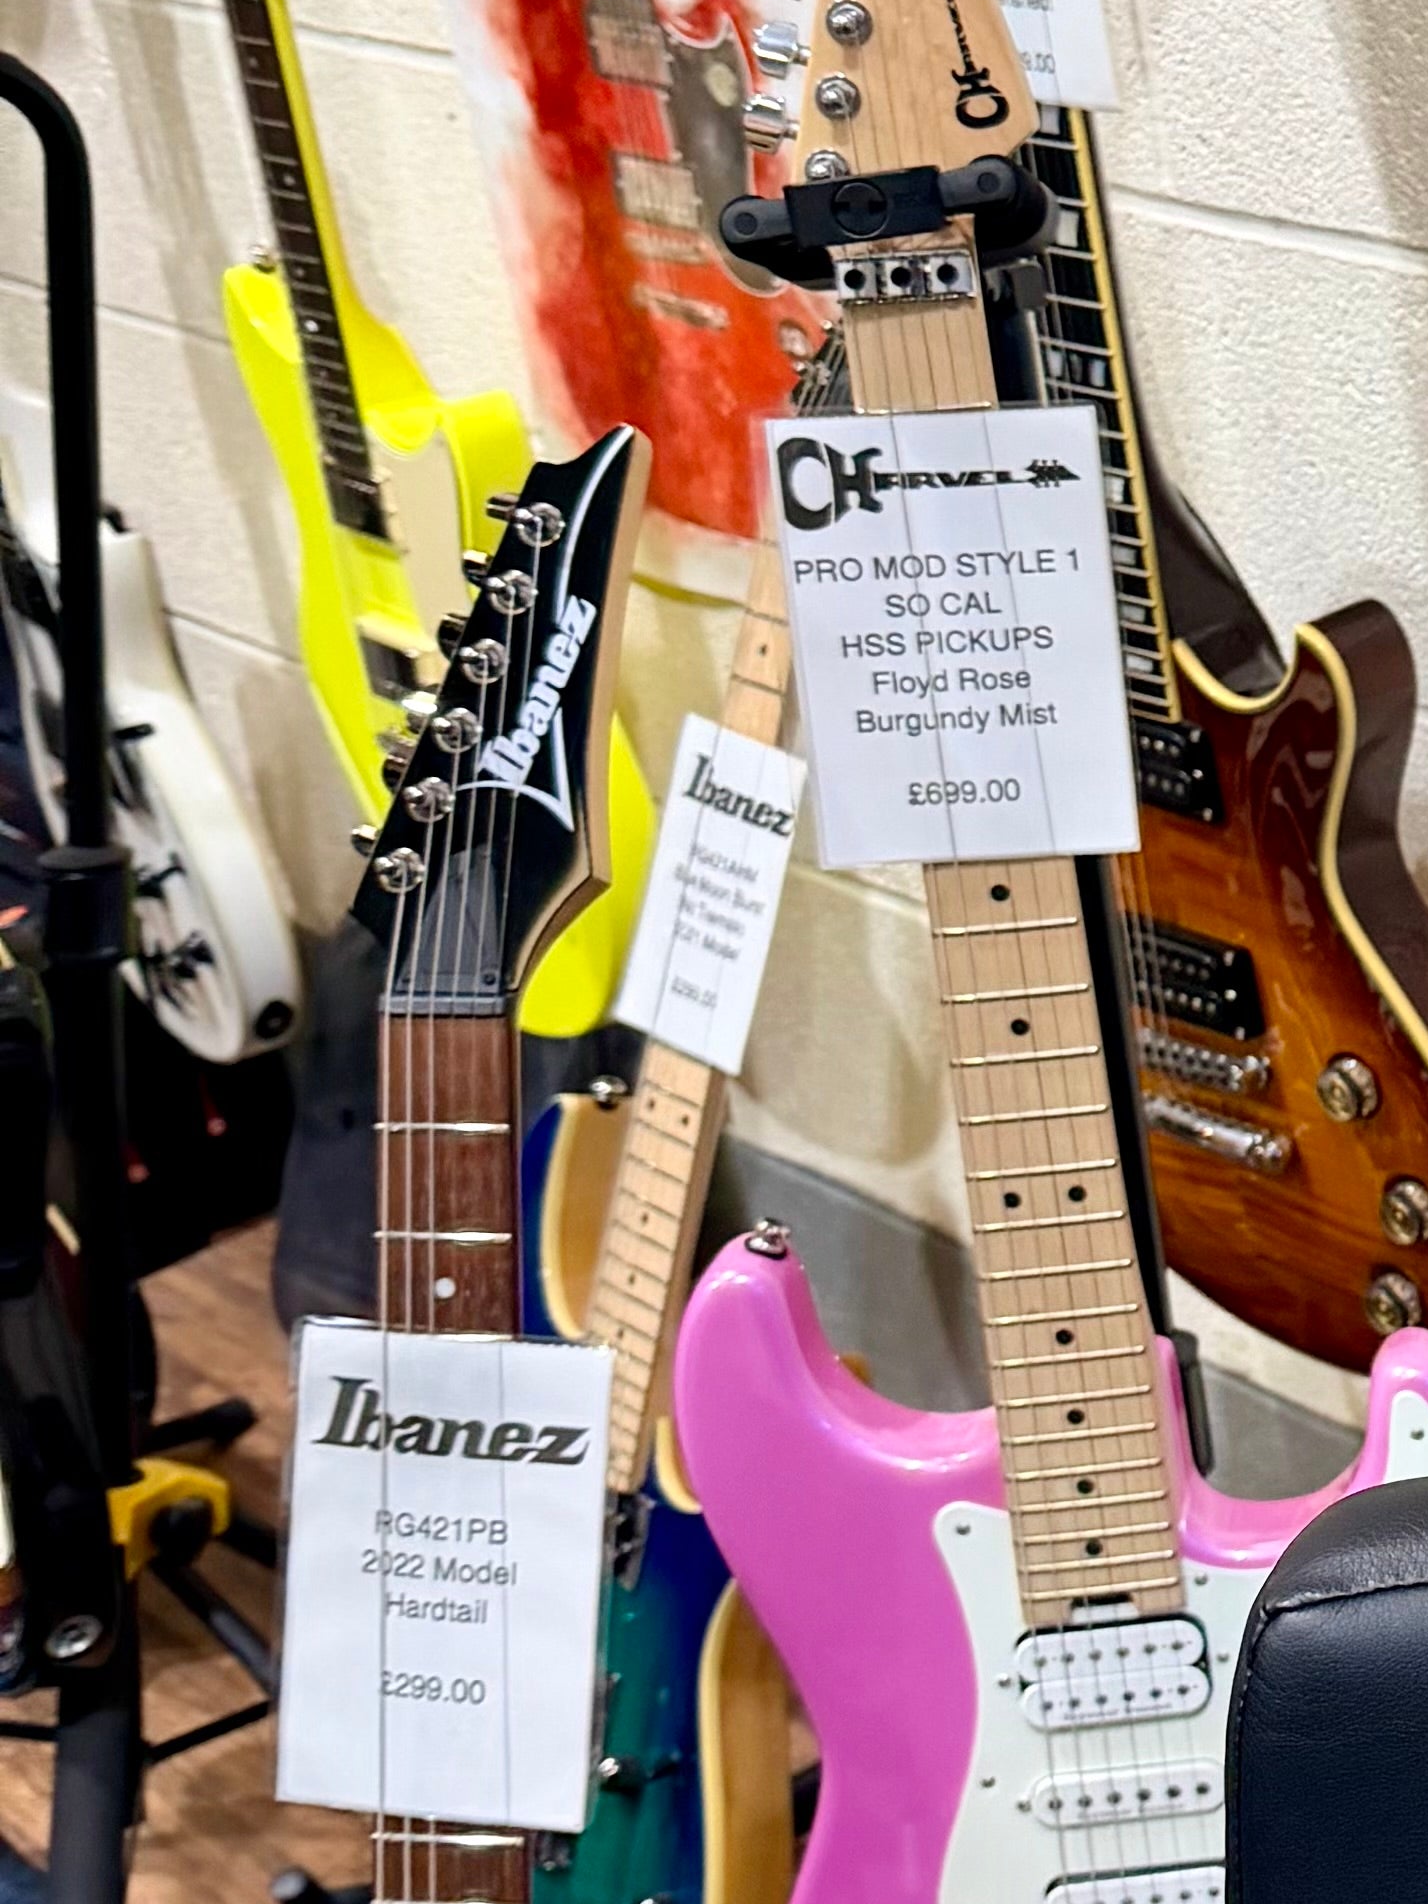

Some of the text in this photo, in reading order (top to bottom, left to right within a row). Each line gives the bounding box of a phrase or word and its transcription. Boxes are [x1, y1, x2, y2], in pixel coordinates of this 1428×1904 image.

[794, 549, 1080, 584] PRO MOD STYLE 1
[885, 591, 1003, 618] SO CAL
[841, 626, 1055, 658] HSS PICKUPS
[478, 594, 597, 786] Ibanez
[873, 668, 1032, 700] Floyd Rose
[856, 703, 1058, 738] Burgundy Mist
[683, 751, 794, 838] Ibanez
[908, 778, 1021, 806] £699.00
[313, 1375, 592, 1466] Ibanez
[374, 1509, 509, 1545] RG421PB
[361, 1549, 518, 1586] 2022 Model
[385, 1593, 488, 1625] Hardtail
[380, 1671, 487, 1706] £299.00
